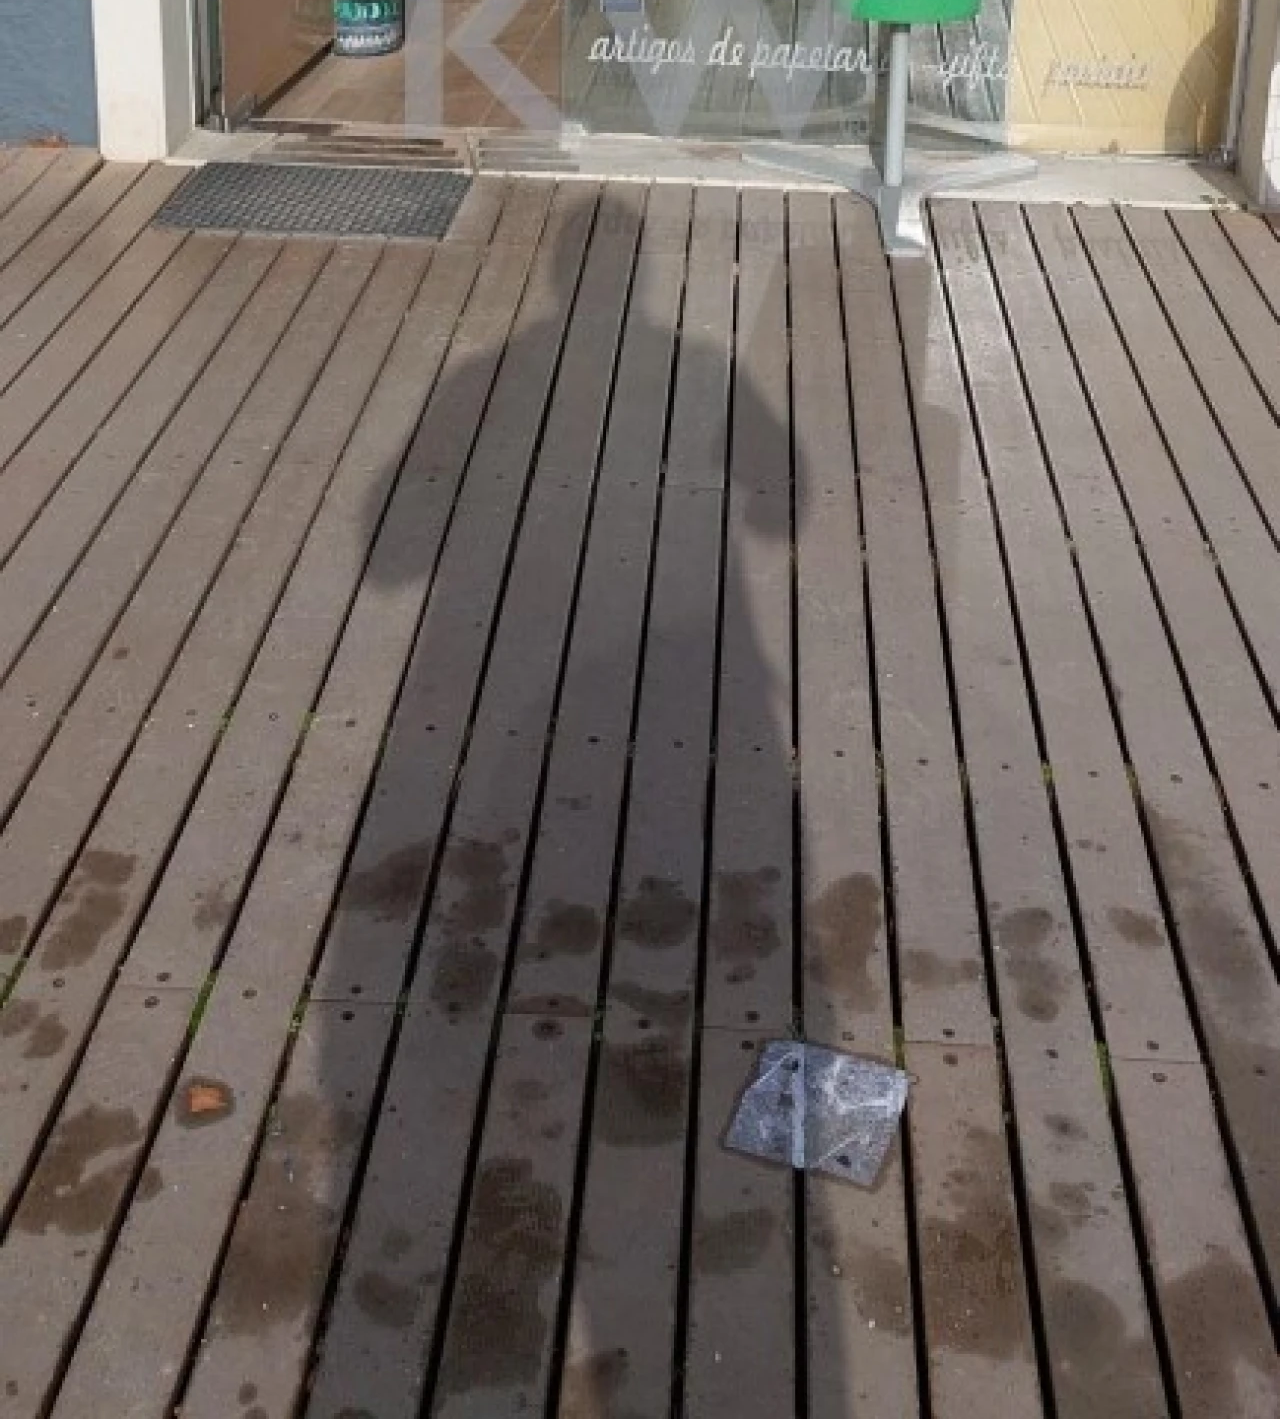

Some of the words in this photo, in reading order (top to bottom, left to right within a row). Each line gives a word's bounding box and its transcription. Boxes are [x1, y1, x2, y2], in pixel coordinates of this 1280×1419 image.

[588, 22, 696, 75] artigos
[704, 26, 746, 66] de
[748, 34, 888, 82] papelar
